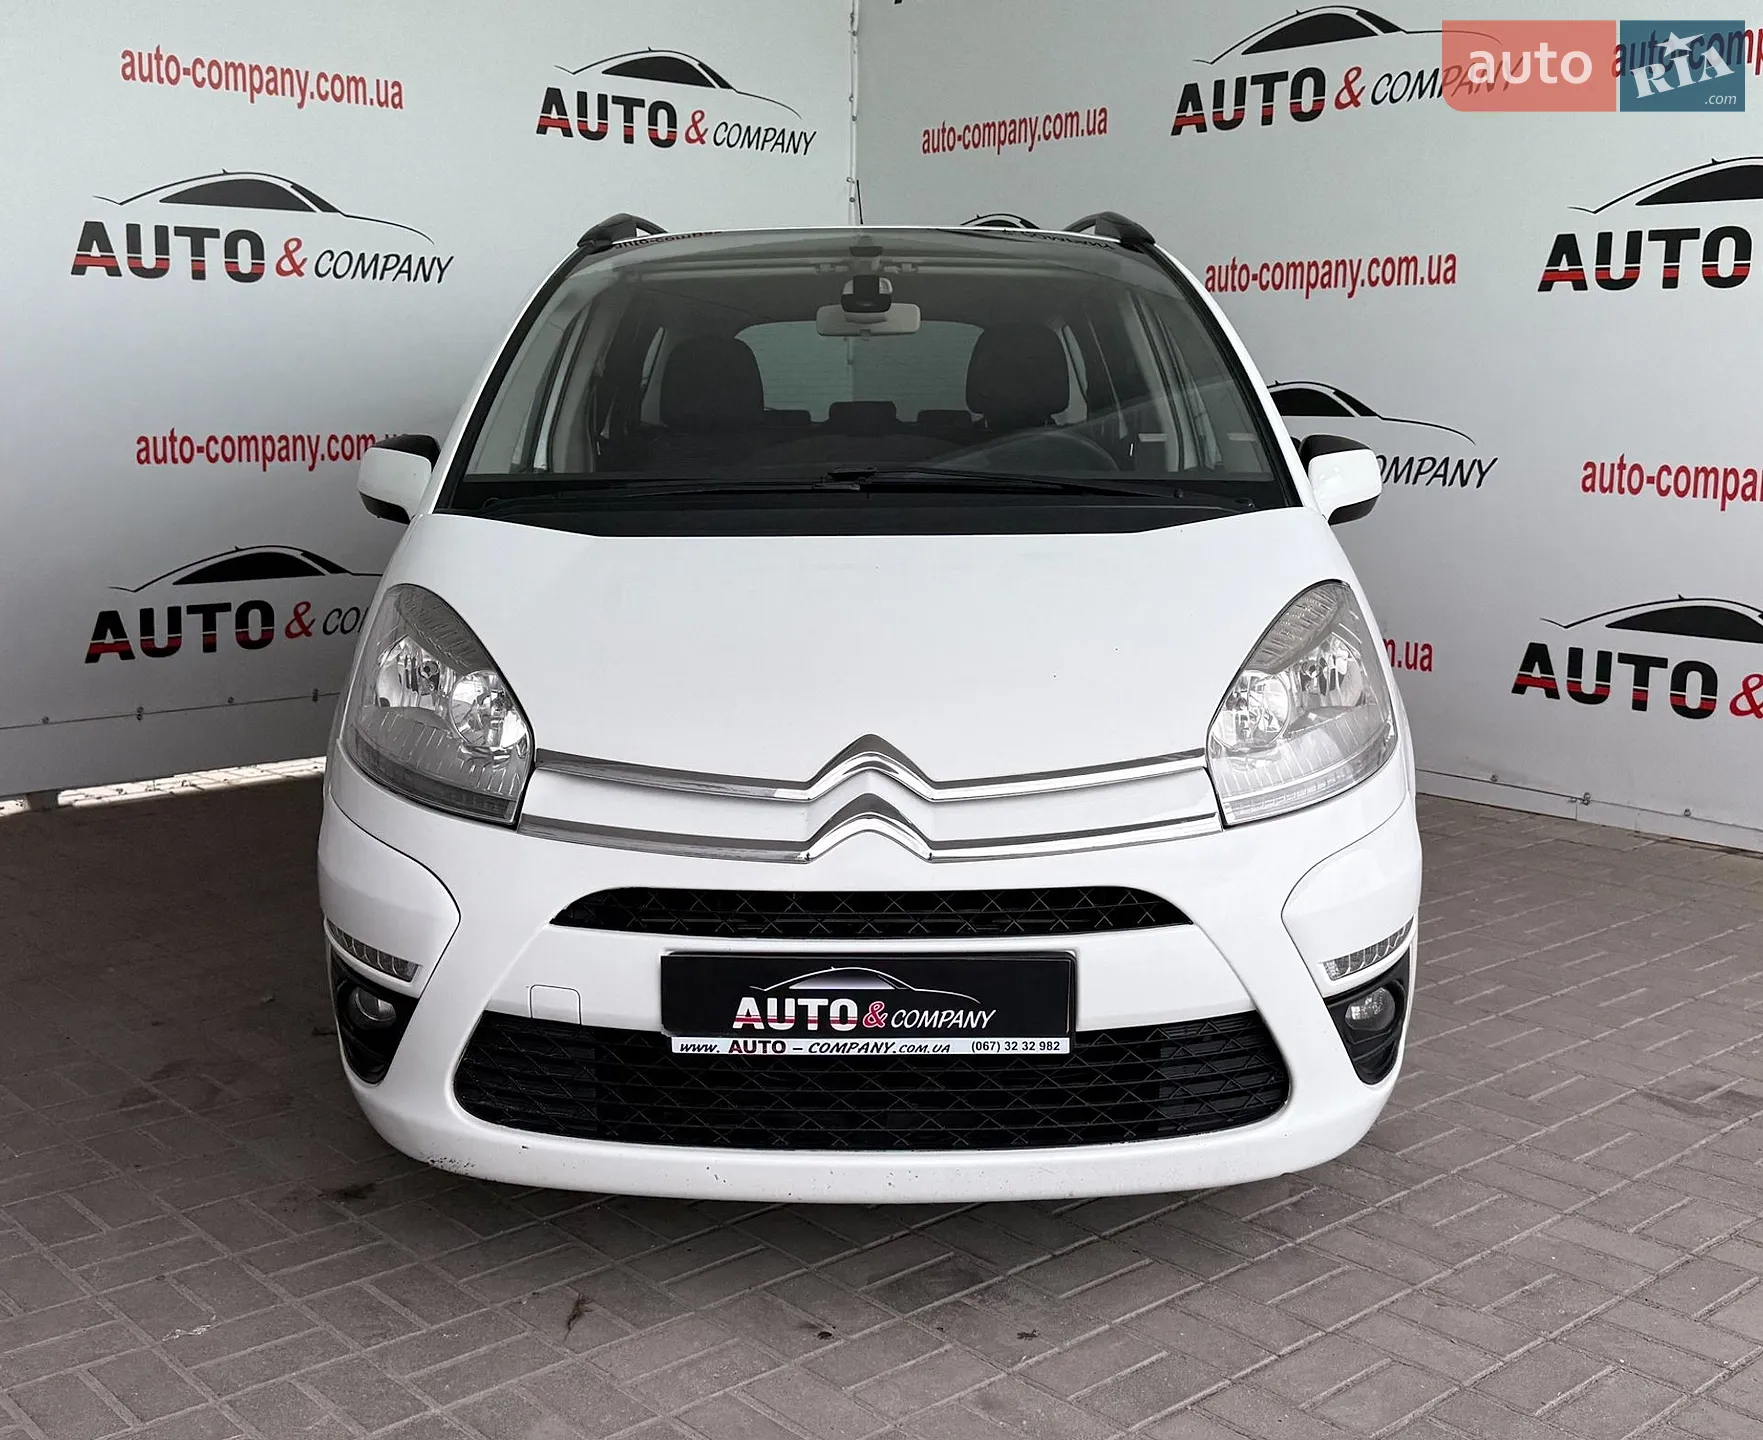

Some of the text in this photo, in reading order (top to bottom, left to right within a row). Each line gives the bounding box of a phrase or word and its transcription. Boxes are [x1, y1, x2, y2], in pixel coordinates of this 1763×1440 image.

[121, 45, 404, 109] auto-company.com.ua
[1171, 67, 1326, 136] AUTO
[1334, 67, 1366, 110] &
[536, 87, 817, 156] AUTO & COMPANY
[922, 107, 1108, 155] auto-company.com.ua
[71, 221, 454, 284] AUTO & COMPANY
[1205, 253, 1456, 299] auto-company.com.ua
[1537, 226, 1753, 292] AUTO
[136, 428, 405, 472] auto-company.com
[1581, 453, 1763, 512] auto-compa
[85, 600, 370, 663] AUTO & CO
[1511, 641, 1718, 720] AUTO
[733, 997, 997, 1031] AUTO & COMPANY
[728, 1039, 787, 1054] AUTO
[971, 1041, 1001, 1053] (067)
[1004, 1041, 1018, 1051] 32
[1021, 1041, 1036, 1051] 32
[1039, 1041, 1060, 1051] 982
